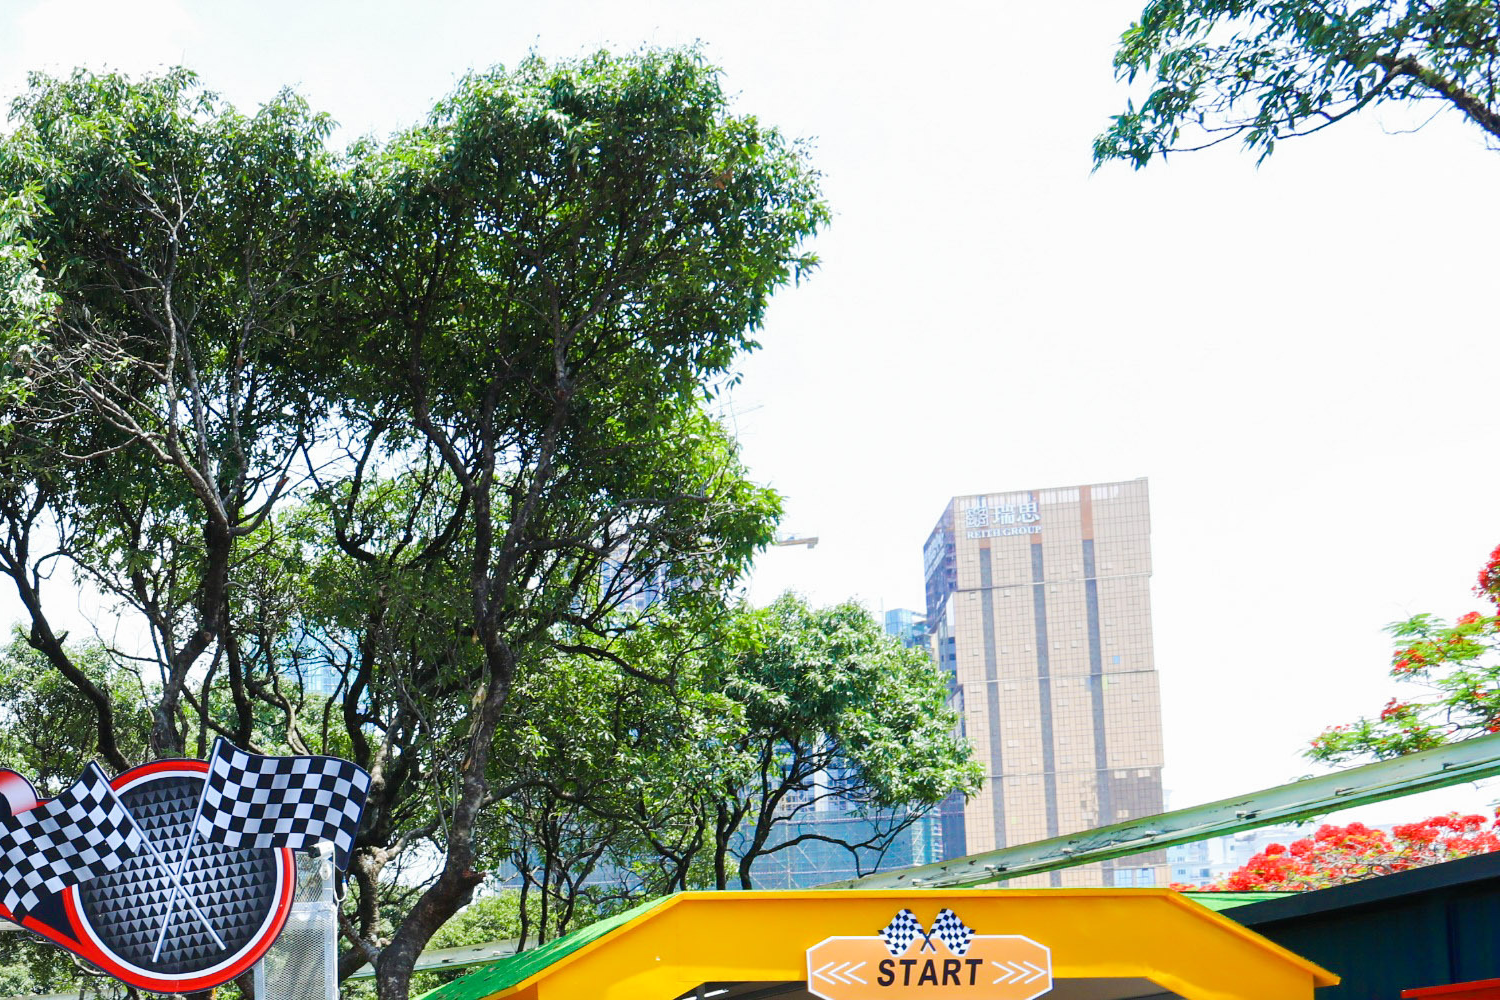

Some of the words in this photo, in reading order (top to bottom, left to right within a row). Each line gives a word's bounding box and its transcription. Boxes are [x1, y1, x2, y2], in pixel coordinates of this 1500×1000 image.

[966, 528, 1001, 540] REITH
[1002, 525, 1043, 537] GROUP
[877, 958, 983, 987] START
